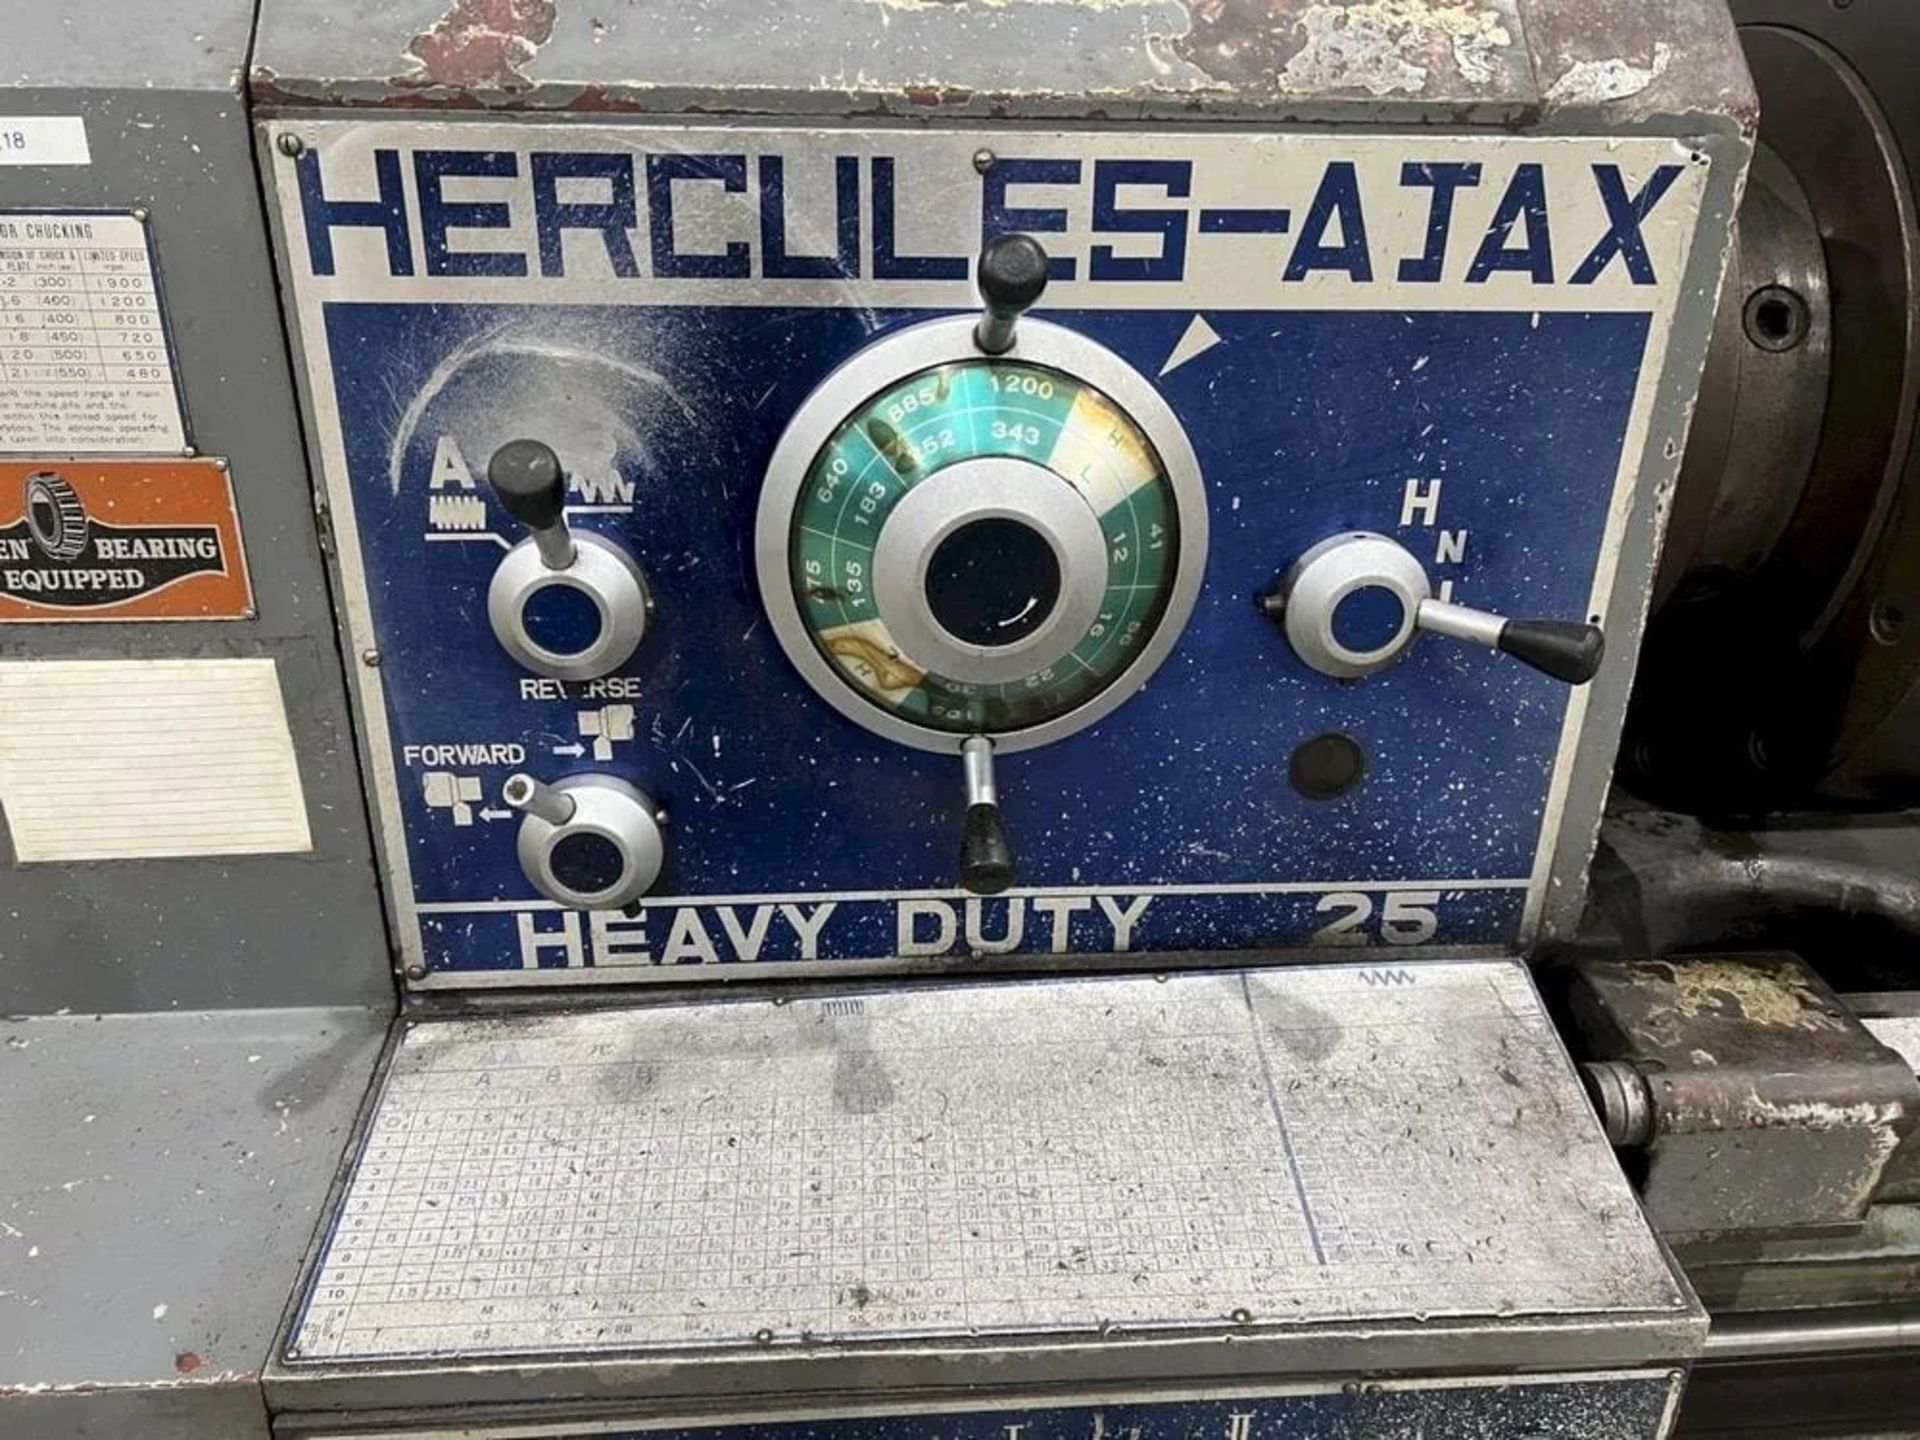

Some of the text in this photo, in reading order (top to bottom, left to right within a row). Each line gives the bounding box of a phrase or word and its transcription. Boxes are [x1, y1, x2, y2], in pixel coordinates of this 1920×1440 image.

[299, 148, 1685, 286] HERCULES-AJAX
[26, 223, 94, 239] CHUCKING
[114, 315, 150, 326] 800
[118, 332, 154, 344] 720
[12, 350, 34, 361] 20
[122, 350, 157, 362] 650
[126, 368, 161, 379] 480
[989, 374, 1054, 400] 1200
[887, 386, 937, 423] 885
[991, 420, 1040, 447] 343
[429, 435, 476, 490] A
[816, 457, 849, 504] 640
[854, 481, 887, 526] 183
[1400, 478, 1442, 526] H
[95, 536, 217, 560] BEARING
[1112, 530, 1129, 564] 12
[1149, 522, 1164, 550] 41
[1435, 529, 1468, 564] N
[4, 568, 146, 592] EQUIPPED
[845, 560, 866, 608] 135
[1089, 612, 1113, 639] 16
[519, 677, 643, 701] RERSE
[403, 744, 526, 767] FORWARD
[516, 894, 1155, 969] HEAVY DUTY
